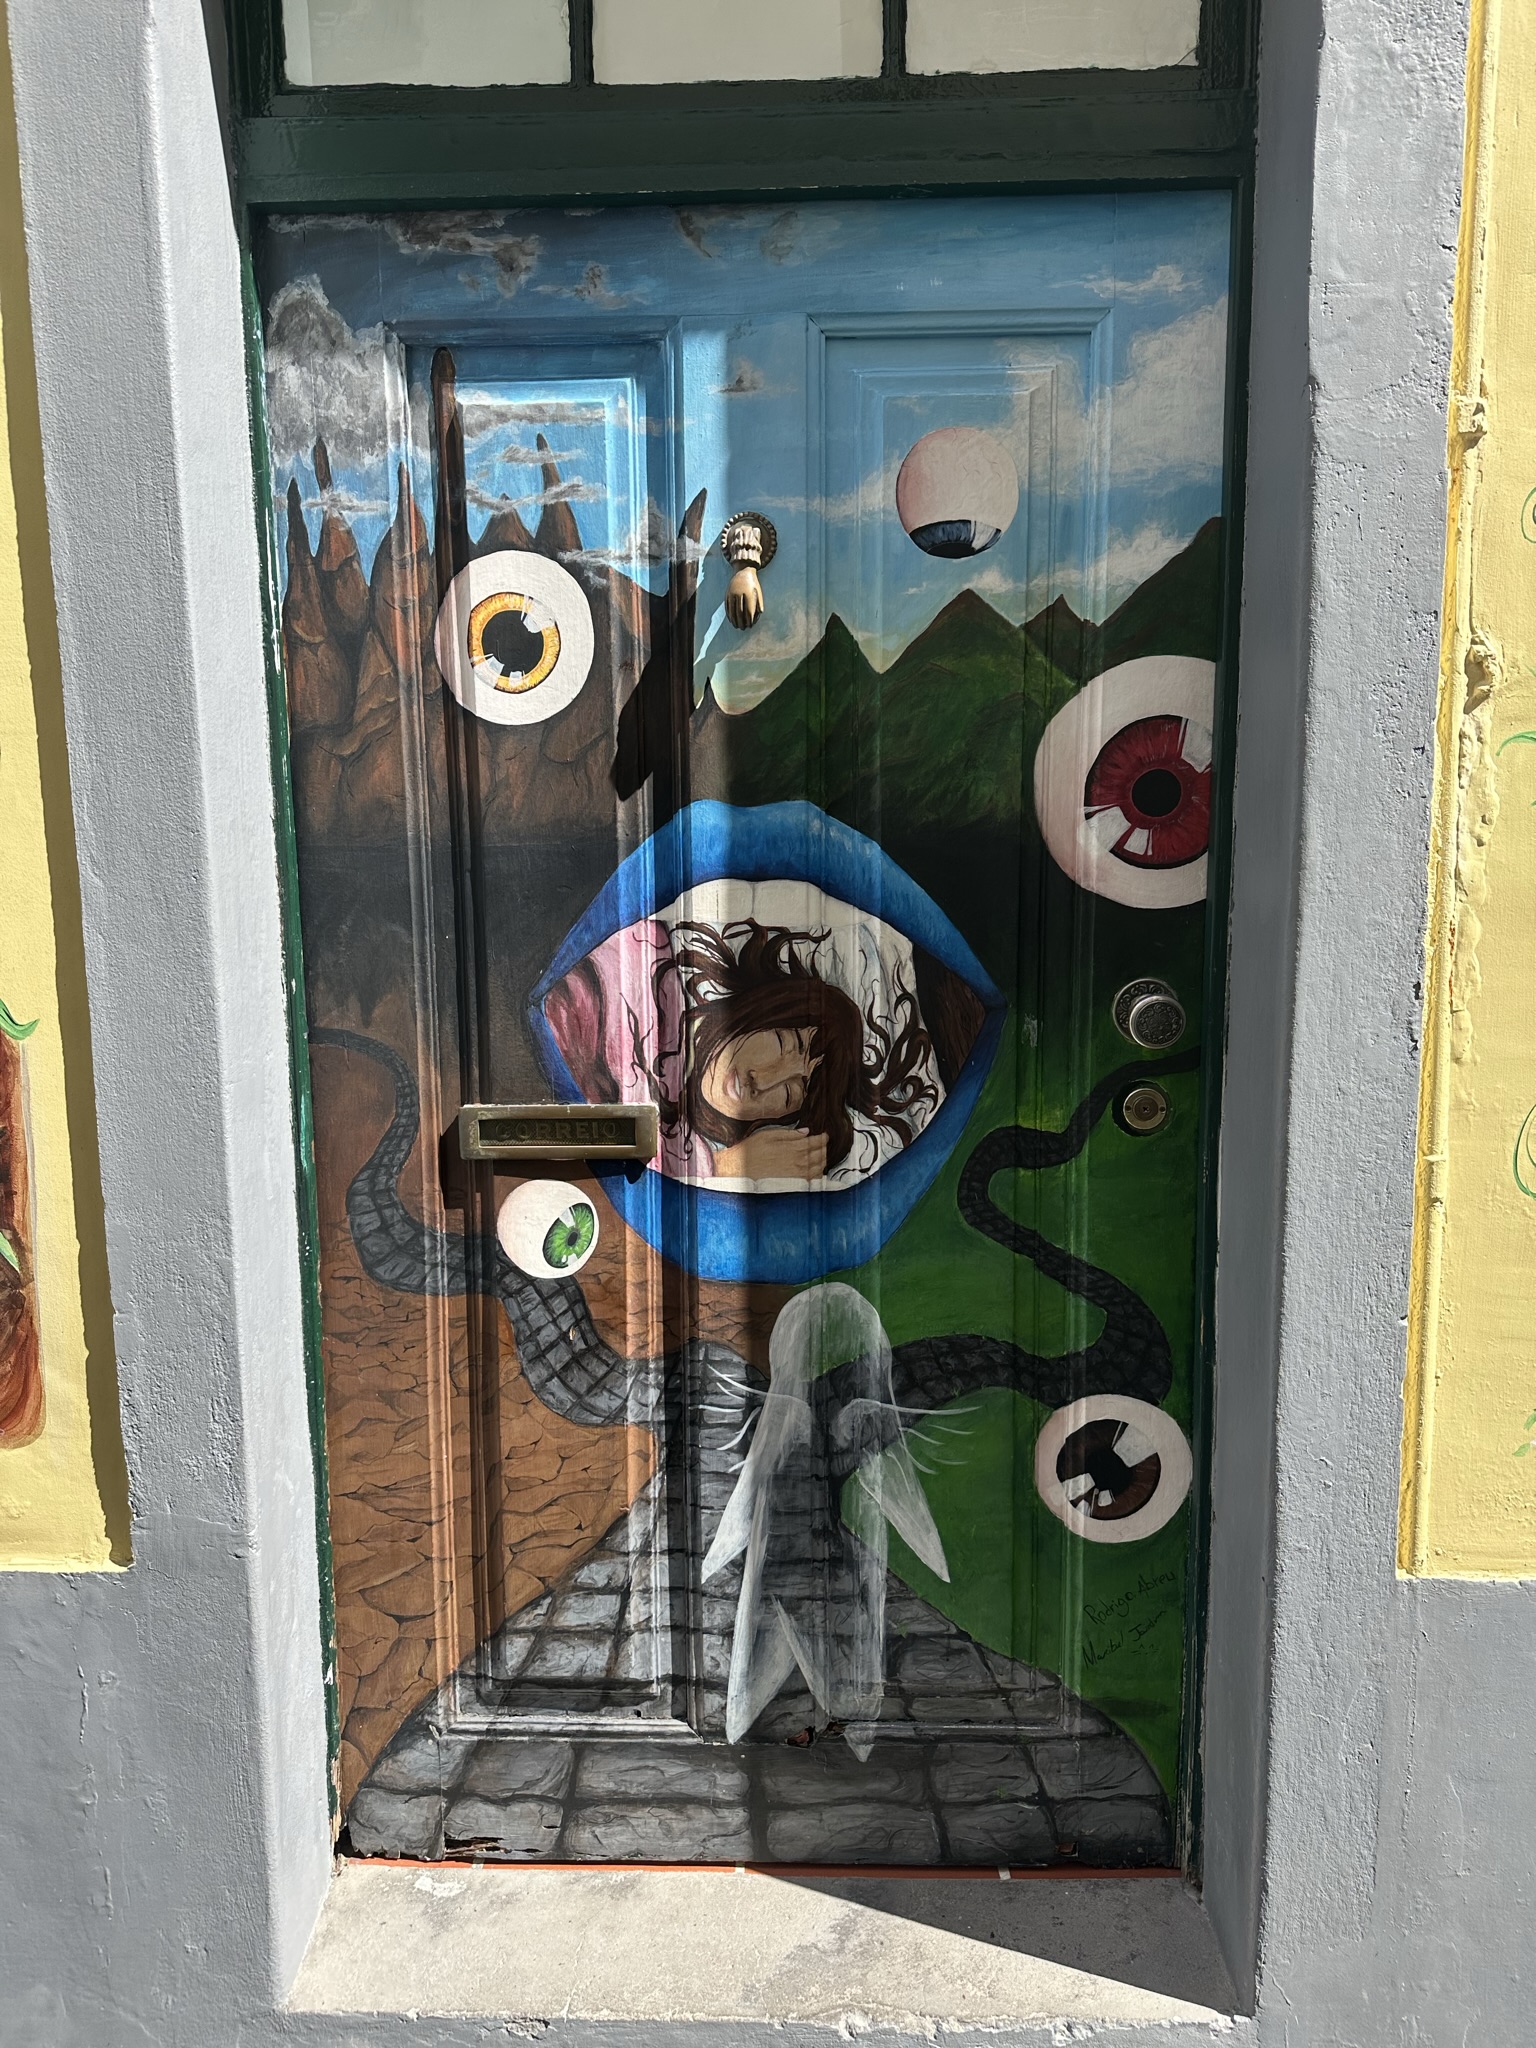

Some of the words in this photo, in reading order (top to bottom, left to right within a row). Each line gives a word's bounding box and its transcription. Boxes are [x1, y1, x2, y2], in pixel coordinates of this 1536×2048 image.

[495, 1121, 621, 1140] CORREIO
[1083, 1590, 1134, 1625] Rodrigo
[1137, 1571, 1176, 1598] Abreu
